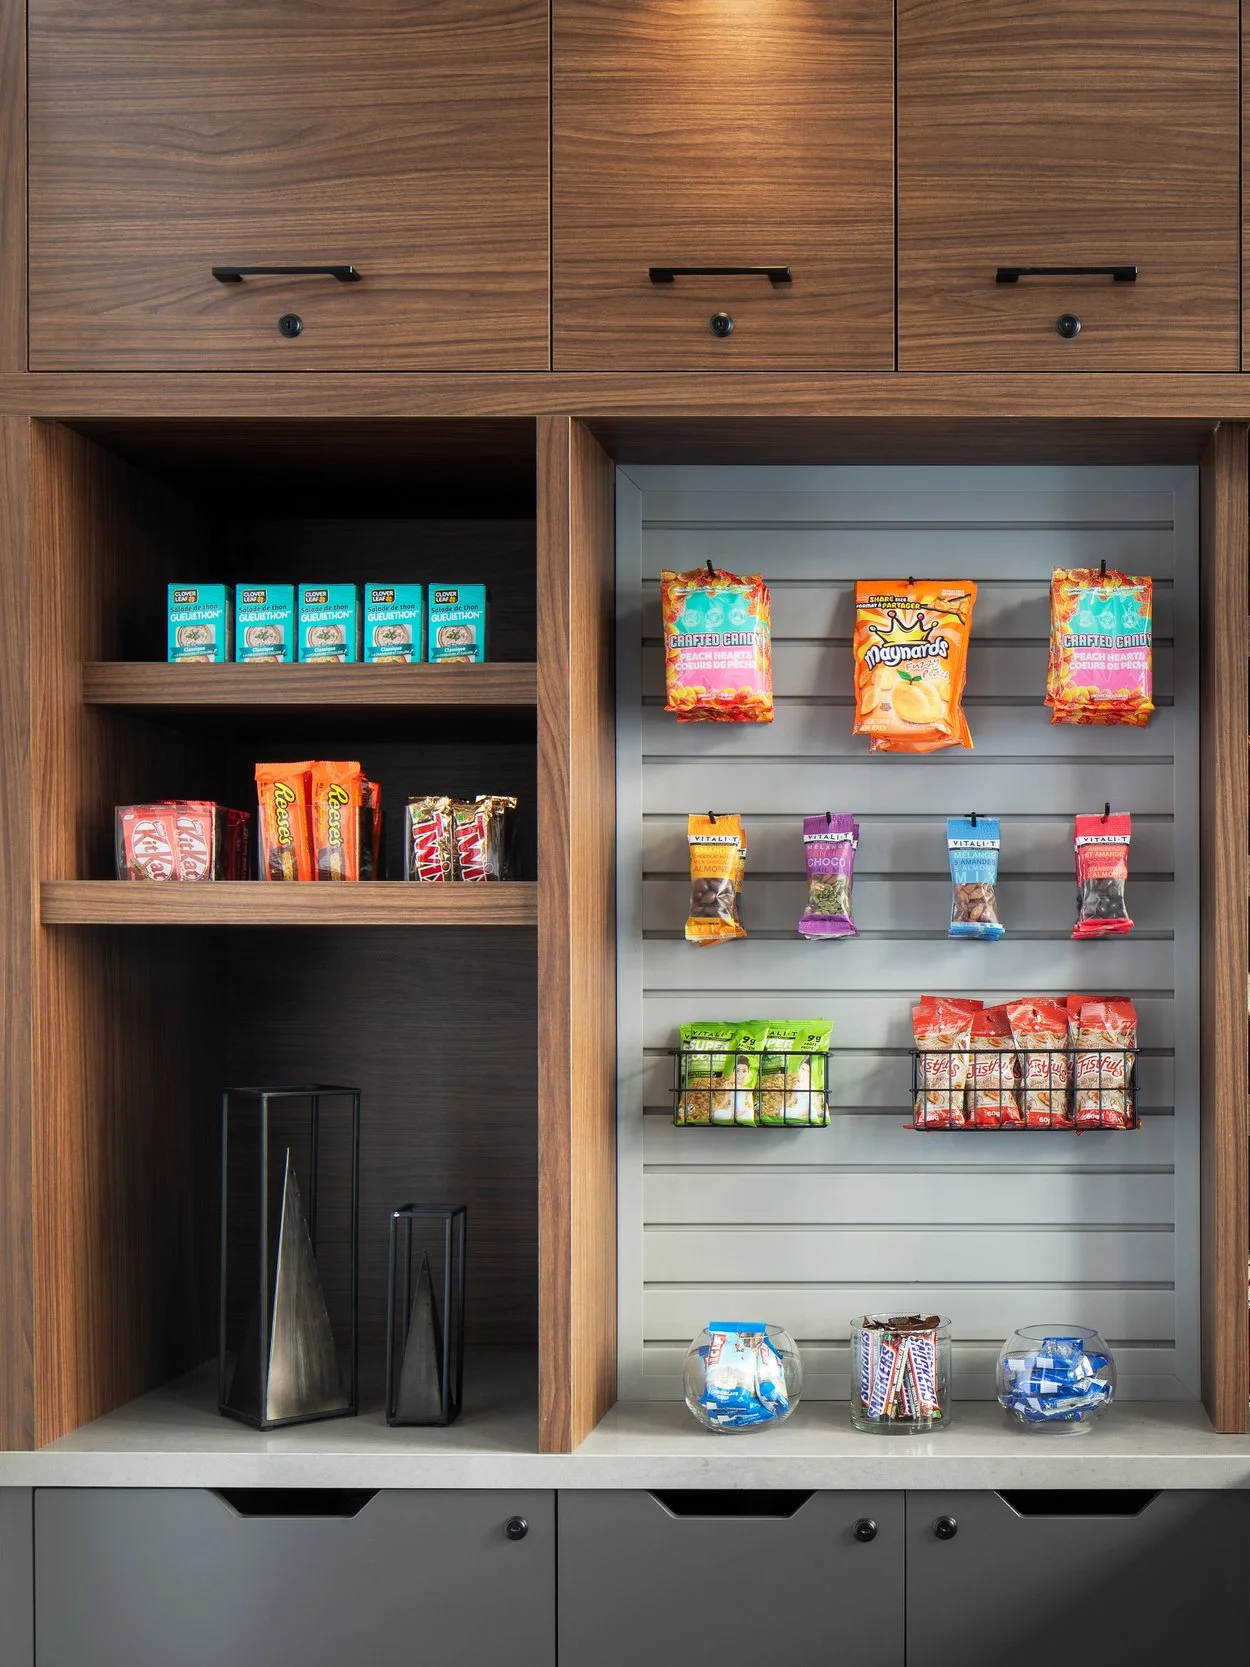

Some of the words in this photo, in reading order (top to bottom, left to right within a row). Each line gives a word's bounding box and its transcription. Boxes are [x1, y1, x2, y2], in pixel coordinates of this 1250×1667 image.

[881, 602, 921, 610] PARTAGER
[669, 634, 720, 648] CRAFTED
[723, 632, 761, 648] CANDY
[1062, 634, 1114, 649] CRAFTED
[1115, 633, 1152, 648] CANDY
[680, 652, 713, 662] PEACH
[714, 651, 752, 661] HEARTS
[864, 636, 949, 671] Maynards
[1073, 652, 1106, 661] PEACH
[1107, 652, 1145, 661] HEARTS
[675, 661, 713, 670] COEURS
[714, 661, 725, 670] DE
[905, 658, 940, 672] Fuzzy
[1069, 662, 1106, 670] COEURS
[1107, 662, 1119, 670] DE
[273, 781, 296, 846] Reese's
[327, 783, 350, 847] Reese's
[954, 851, 996, 859] MÉLANGE
[807, 857, 846, 868] CHOCO
[689, 1040, 729, 1051] SUPER
[868, 1346, 894, 1418] SNICKERS
